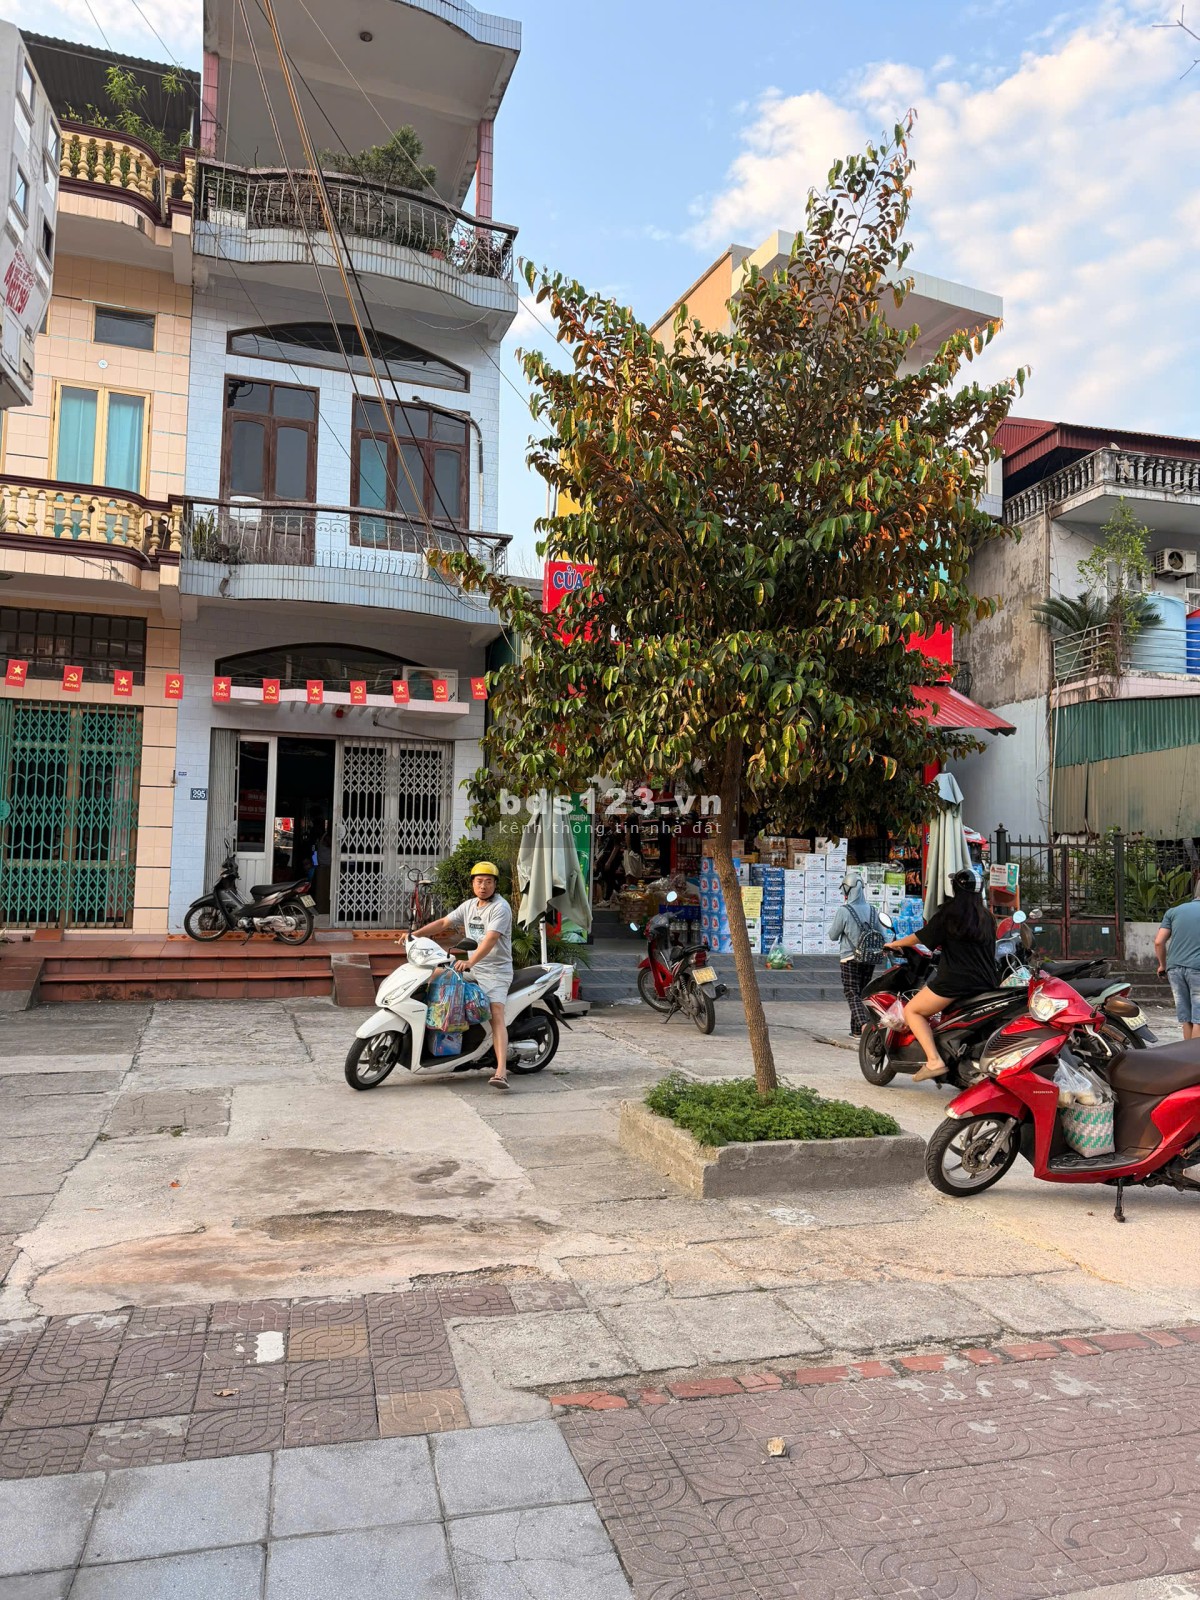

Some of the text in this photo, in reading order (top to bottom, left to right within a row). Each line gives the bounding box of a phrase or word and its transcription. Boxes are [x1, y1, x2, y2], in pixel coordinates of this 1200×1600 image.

[553, 565, 584, 591] CỬA
[8, 674, 23, 682] CHÚC
[192, 789, 206, 799] 295
